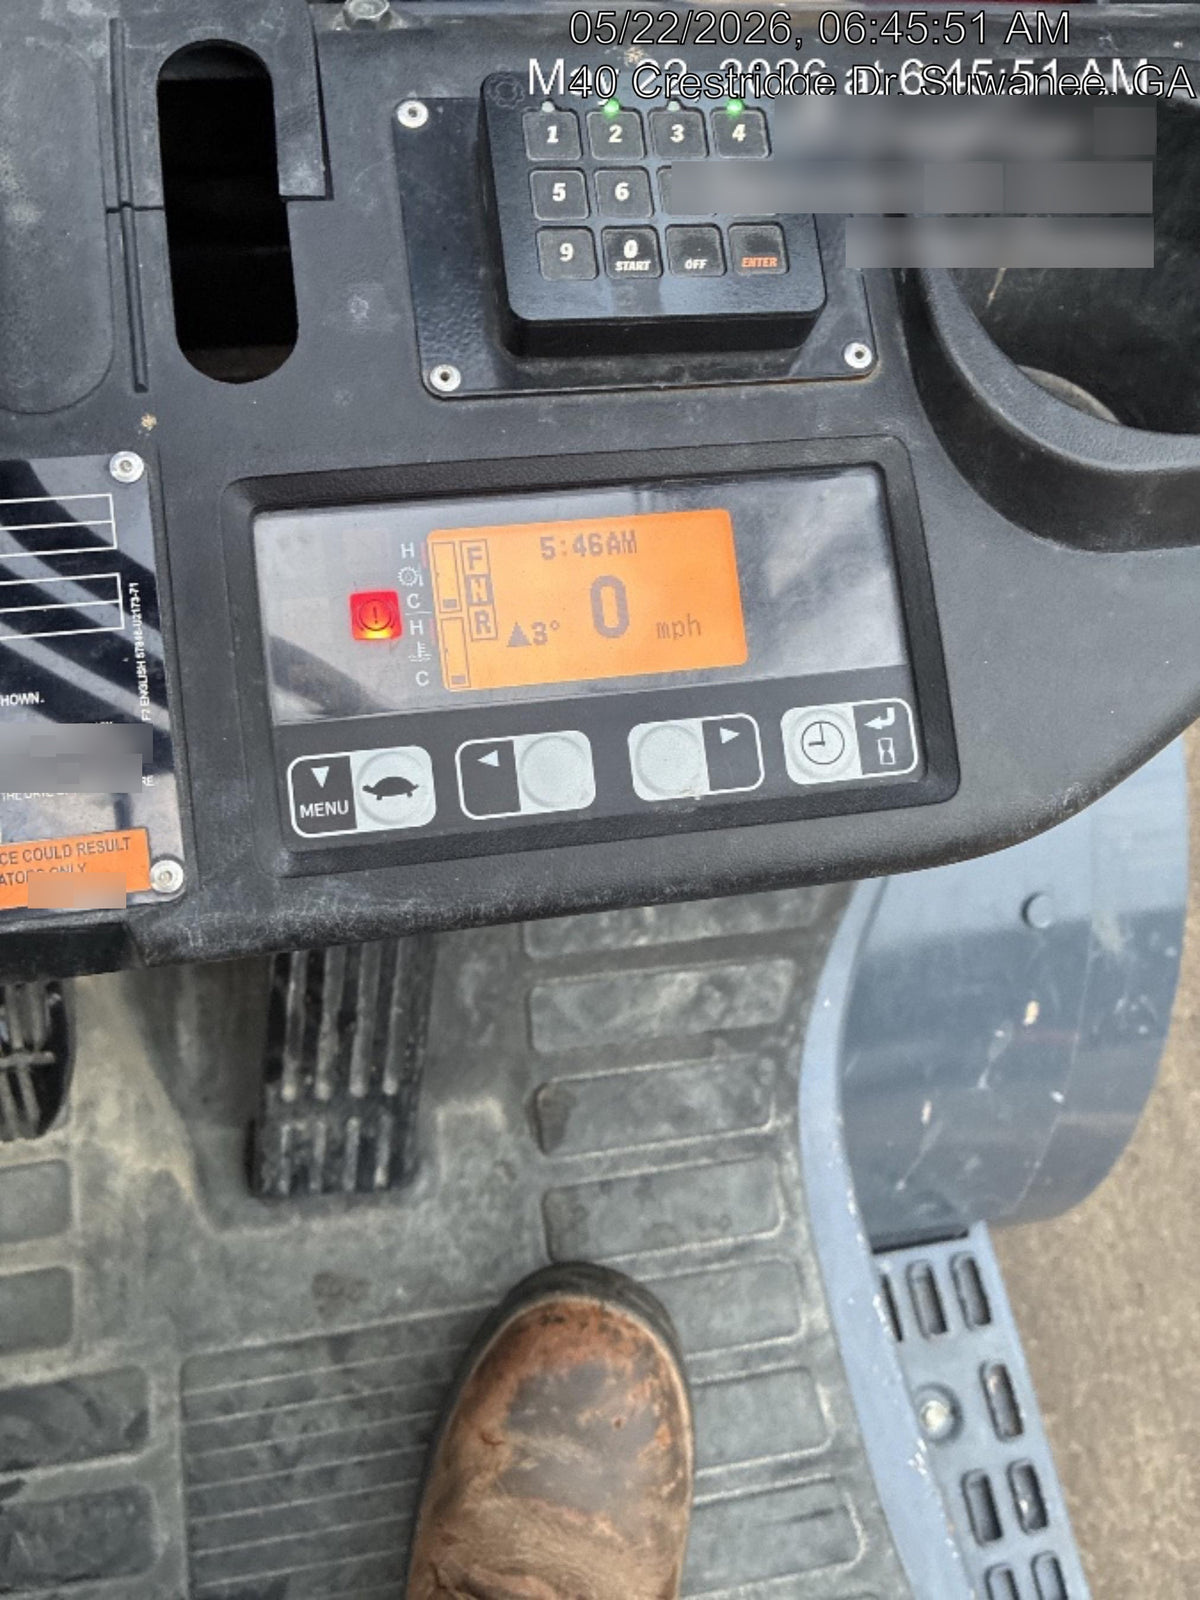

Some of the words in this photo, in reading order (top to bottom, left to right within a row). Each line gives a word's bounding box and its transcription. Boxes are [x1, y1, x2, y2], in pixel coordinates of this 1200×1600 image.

[546, 125, 559, 143] 1
[608, 125, 623, 143] 2
[669, 124, 685, 143] 3
[731, 123, 746, 142] 4
[552, 182, 566, 202] 5
[614, 182, 630, 201] 6
[559, 242, 574, 262] 9
[623, 239, 639, 259] 0
[614, 260, 651, 272] START
[684, 258, 708, 270] OFF
[741, 256, 778, 268] ENTER
[401, 543, 415, 559] H
[540, 529, 638, 561] 5:46AM
[466, 545, 483, 571] F
[406, 593, 421, 610] C
[589, 574, 631, 639] 0
[655, 613, 702, 641] mph
[410, 619, 424, 635] H
[474, 609, 491, 635] R
[415, 670, 430, 687] C
[299, 799, 350, 820] MENU
[22, 844, 73, 863] COULD
[76, 836, 131, 857] RESULT
